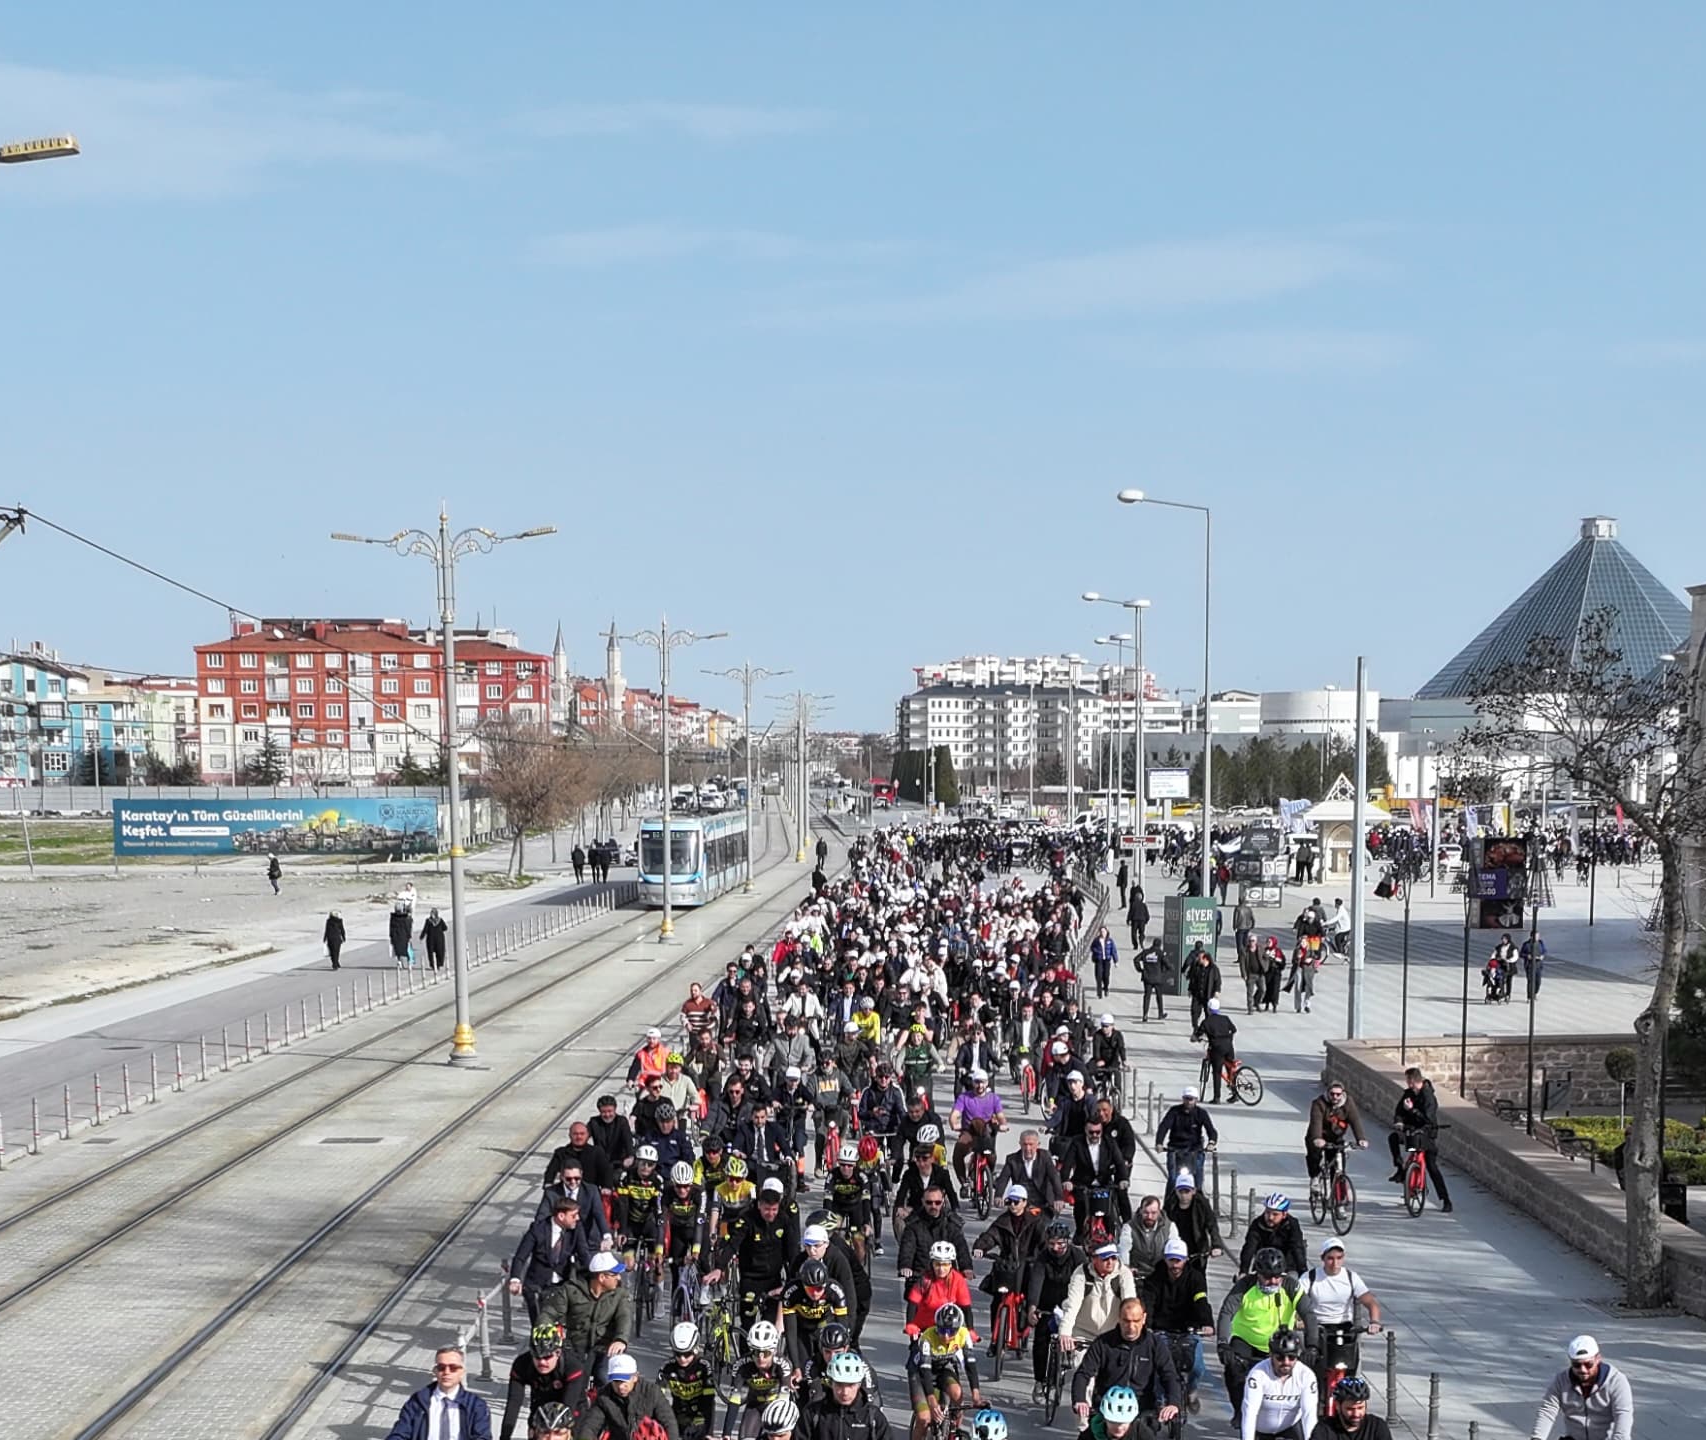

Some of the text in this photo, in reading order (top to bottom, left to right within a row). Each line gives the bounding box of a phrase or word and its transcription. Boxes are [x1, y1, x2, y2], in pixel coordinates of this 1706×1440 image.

[121, 809, 303, 824] Karatay'ın Tüm Güzelliklerini
[122, 825, 167, 839] Keşfet.
